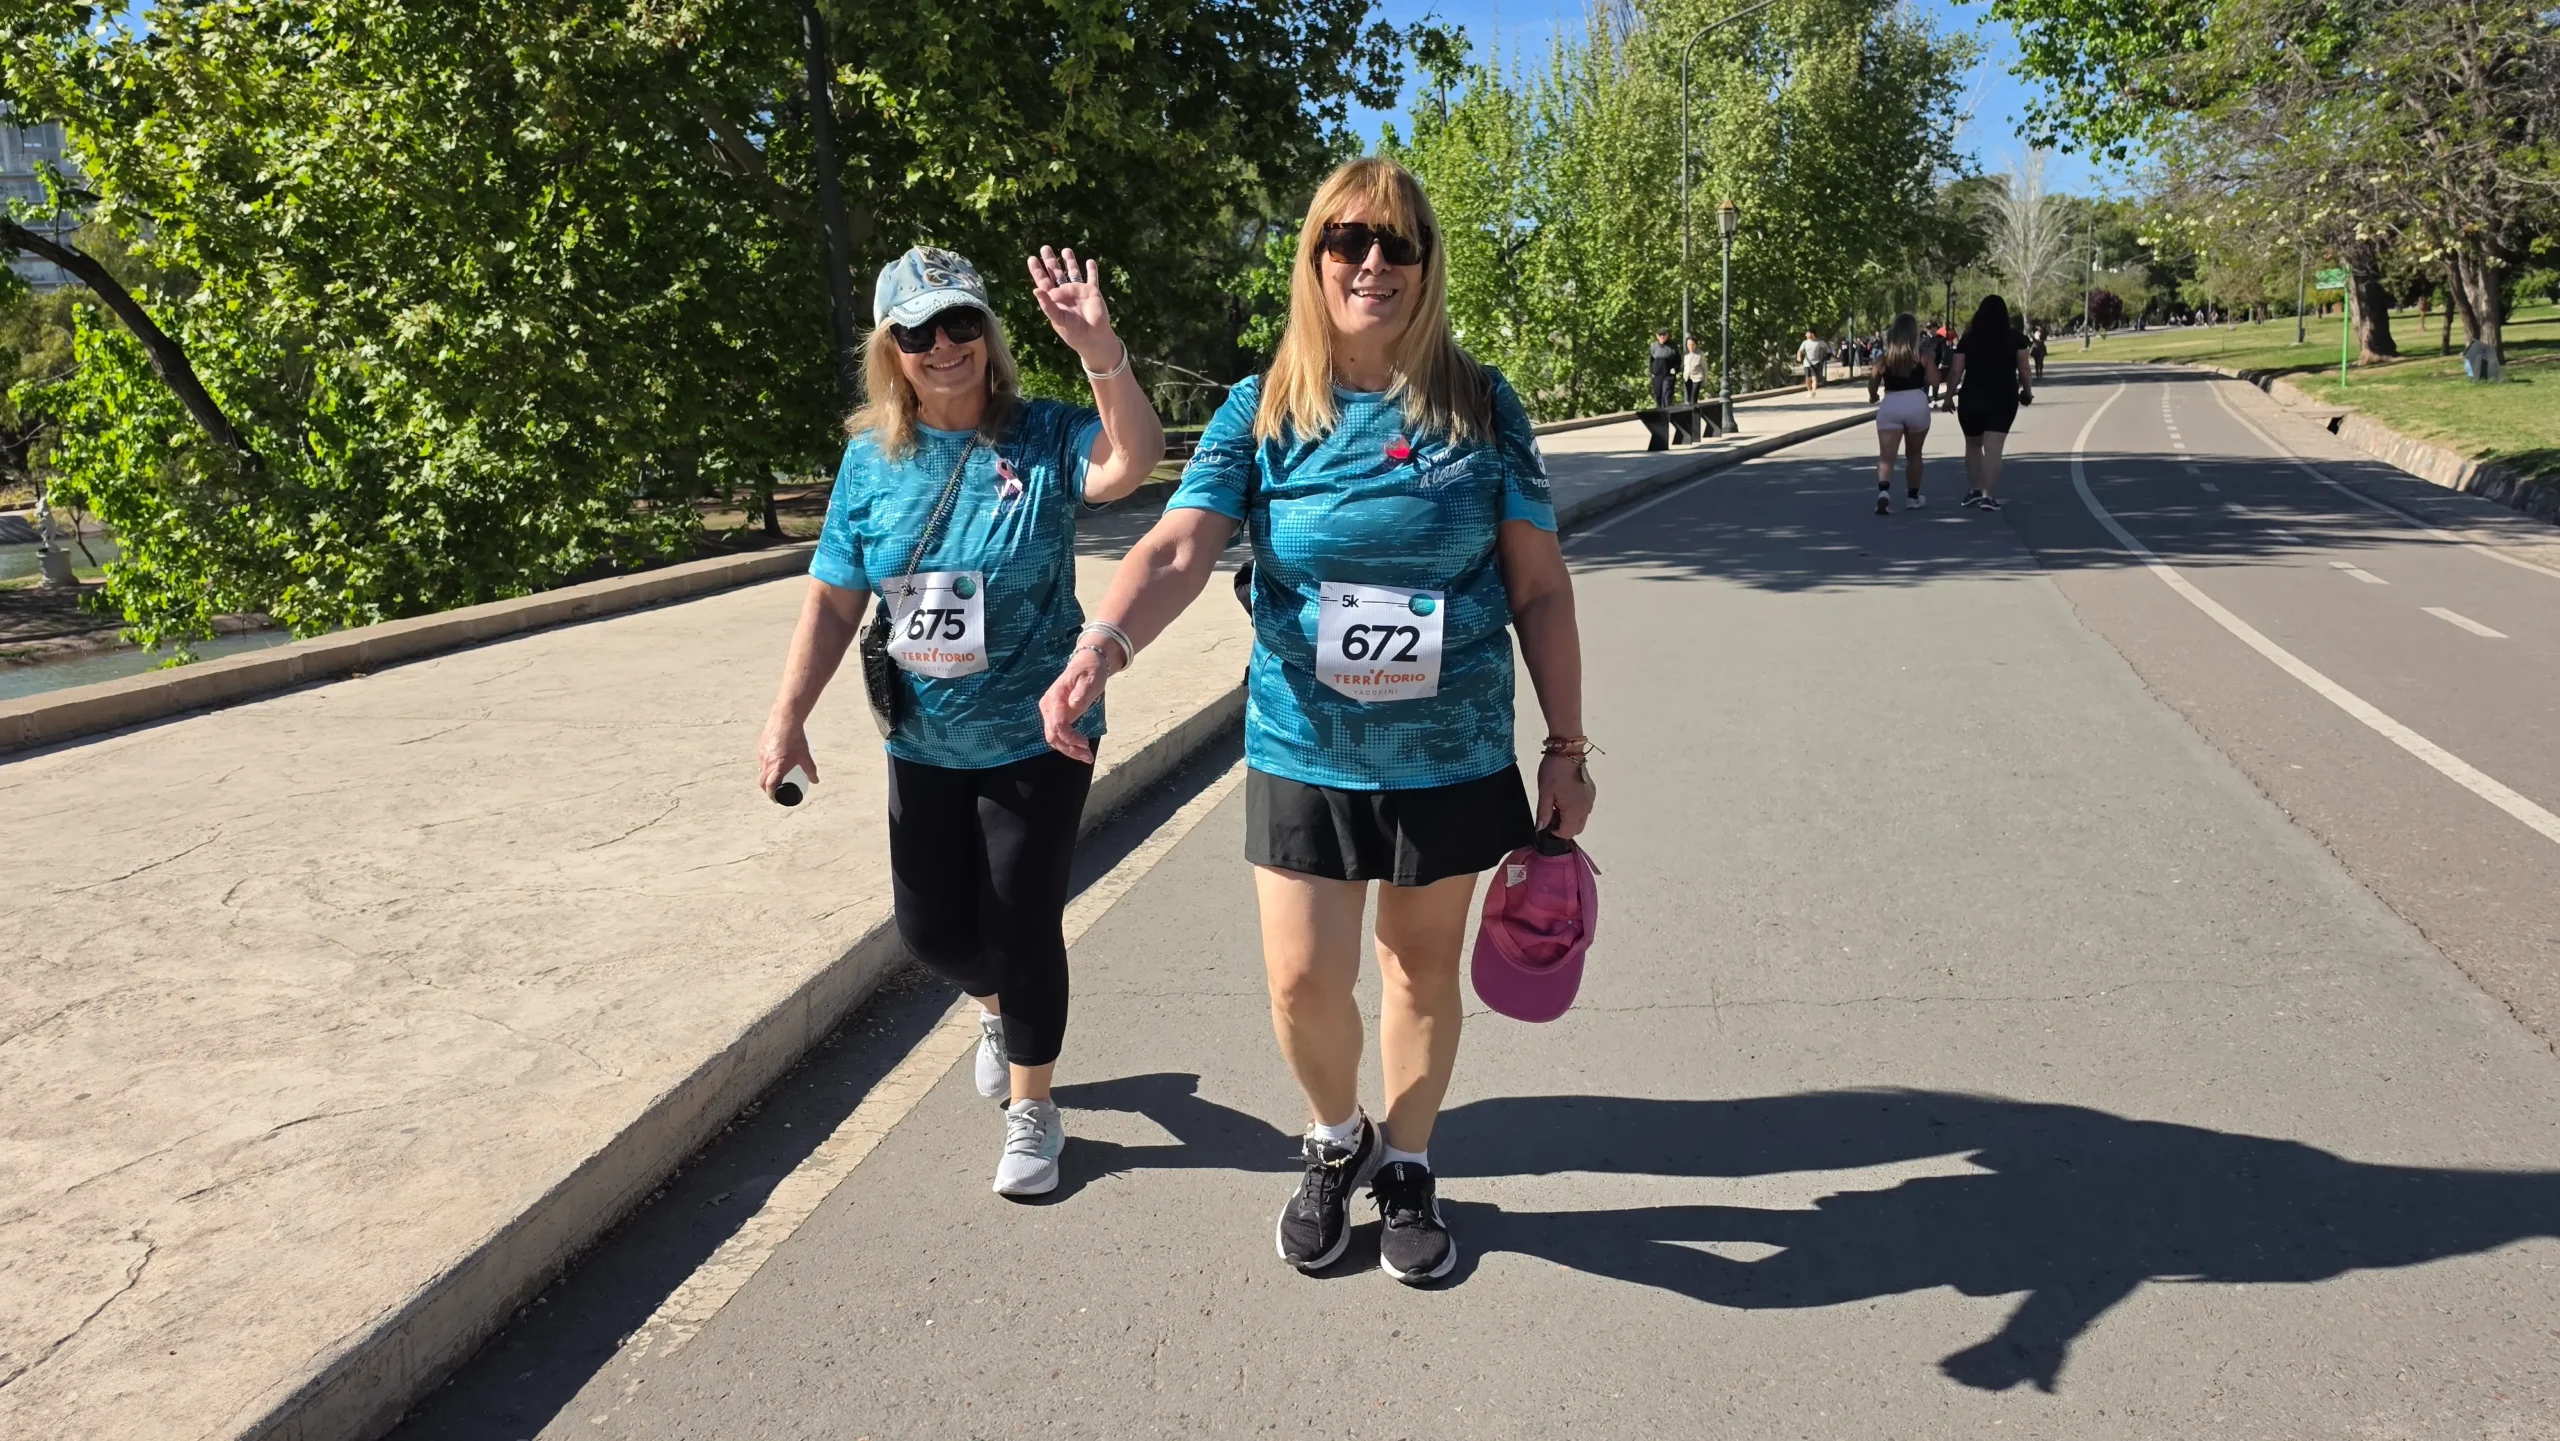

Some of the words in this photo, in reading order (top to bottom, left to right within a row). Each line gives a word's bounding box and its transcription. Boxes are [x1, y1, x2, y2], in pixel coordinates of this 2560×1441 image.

[1342, 595, 1359, 608] 5k
[907, 608, 966, 641] 675
[1341, 623, 1421, 663] 672
[1353, 688, 1399, 697] YACOPINI
